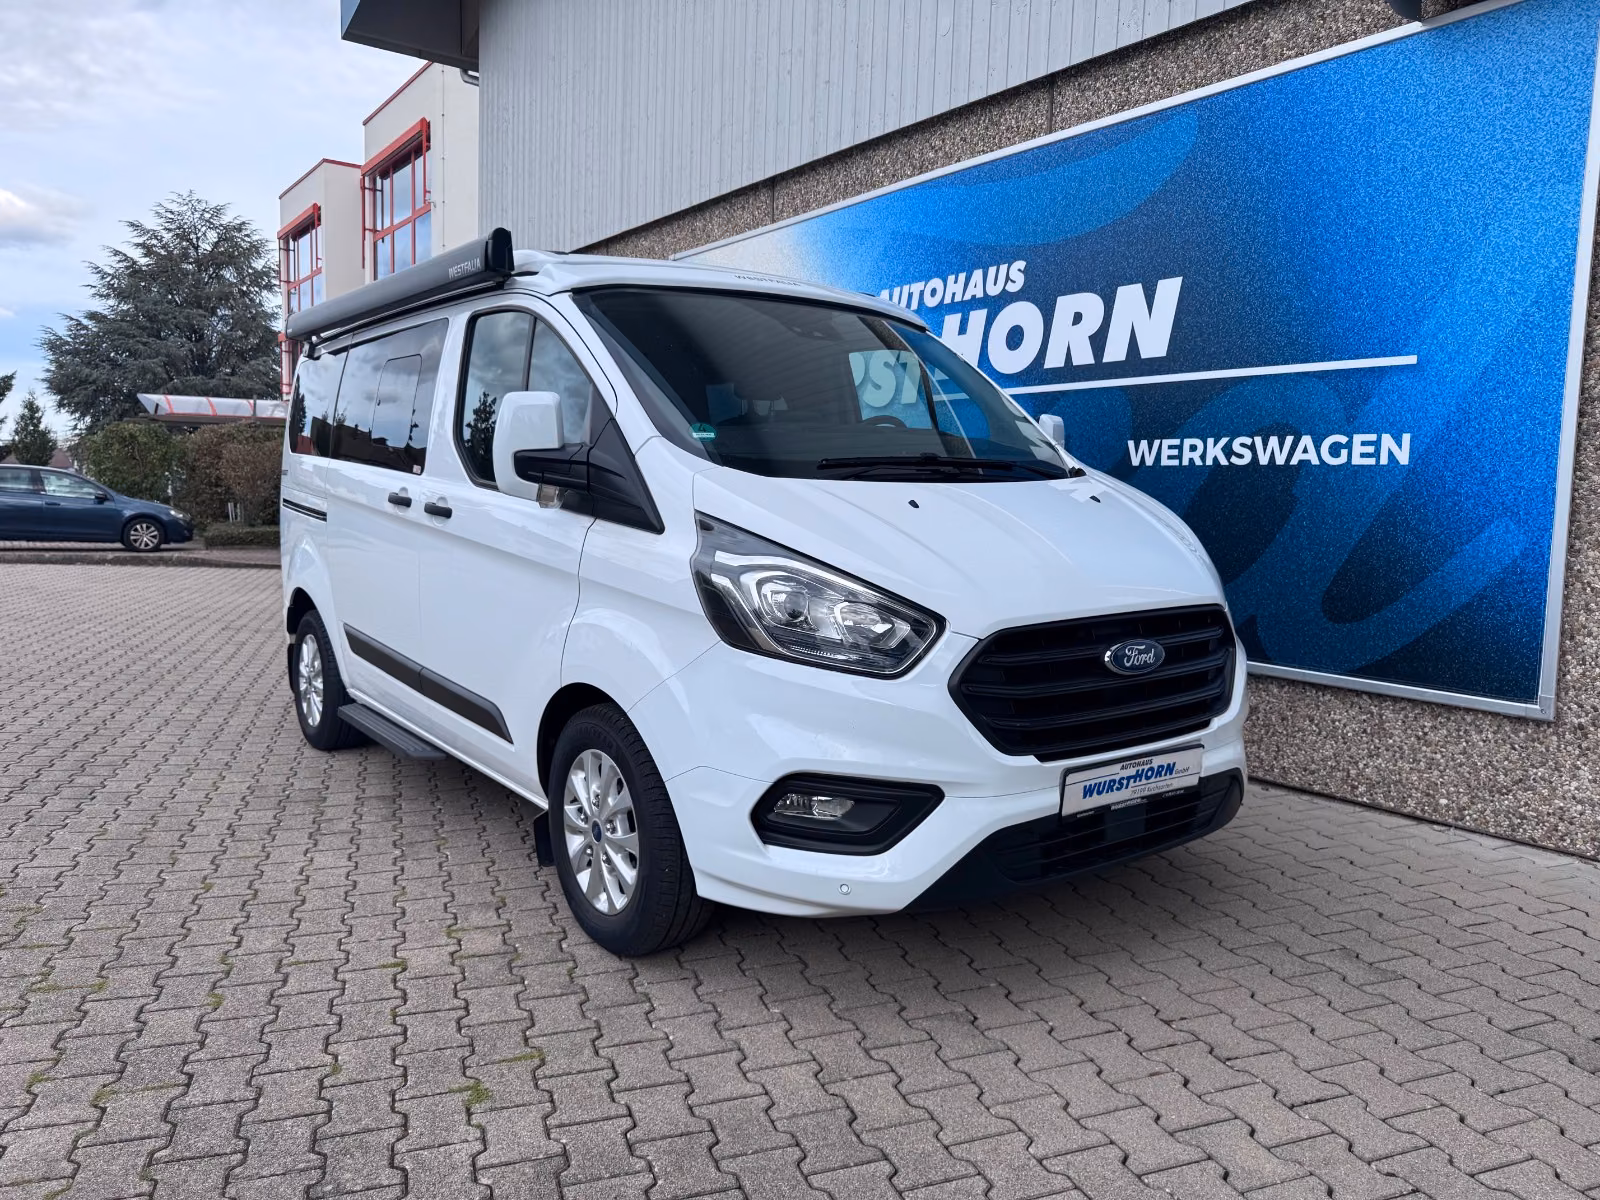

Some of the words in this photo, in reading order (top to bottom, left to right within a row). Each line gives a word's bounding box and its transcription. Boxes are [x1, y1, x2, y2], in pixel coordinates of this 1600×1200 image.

[448, 256, 481, 279] WESTFALIA
[1127, 433, 1411, 467] WERKSWAGEN
[1123, 644, 1156, 667] Ford
[1119, 758, 1154, 771] AUTOHAUS
[1082, 761, 1177, 799] WURSTHORN
[1174, 766, 1190, 775] GmbH
